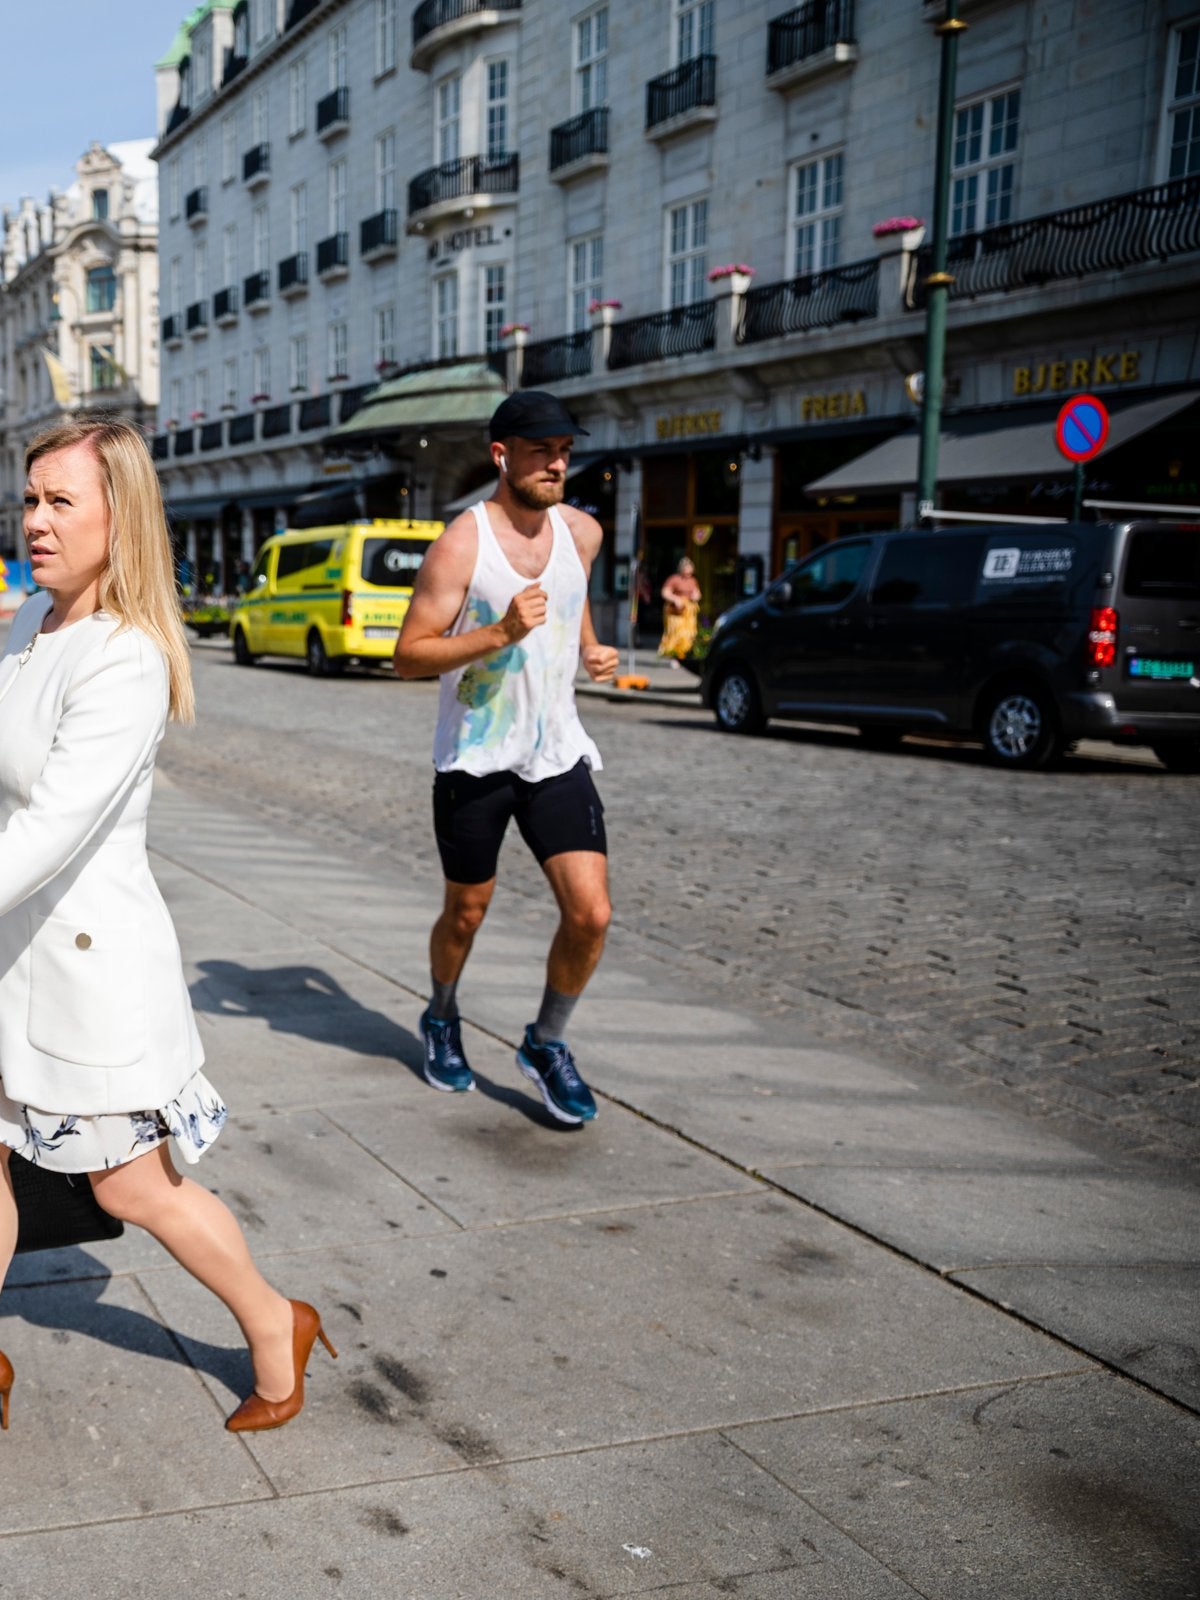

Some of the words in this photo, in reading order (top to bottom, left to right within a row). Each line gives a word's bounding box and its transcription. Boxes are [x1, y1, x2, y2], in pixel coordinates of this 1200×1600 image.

[444, 225, 501, 254] HOTEL
[1013, 352, 1140, 394] BJERKE
[802, 388, 866, 421] FREIA
